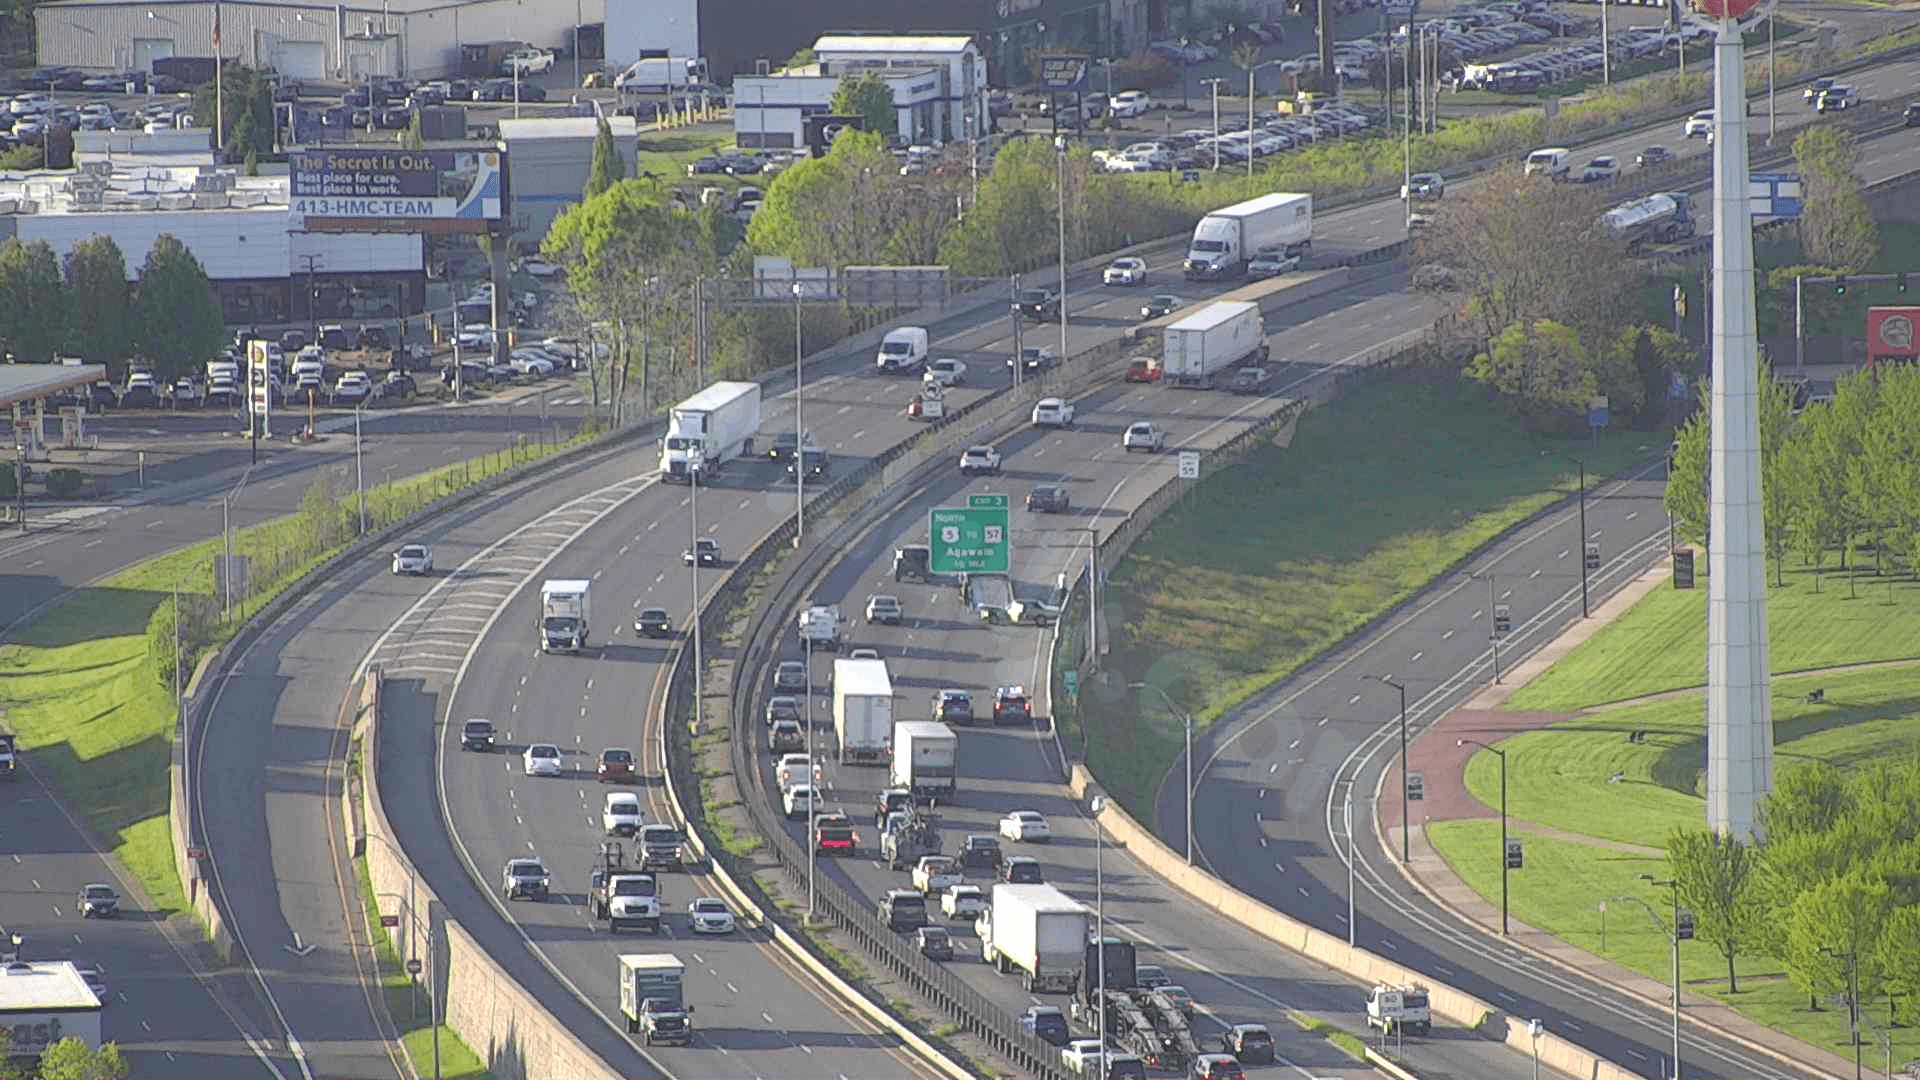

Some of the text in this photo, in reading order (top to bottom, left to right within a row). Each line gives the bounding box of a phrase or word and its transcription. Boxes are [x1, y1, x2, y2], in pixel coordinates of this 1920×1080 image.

[295, 155, 434, 170] The Secret Is Out.
[296, 172, 400, 185] Best place for care.
[296, 184, 400, 196] Best place to work.
[295, 200, 433, 215] 413-HMC-TEAM
[995, 496, 1002, 506] 3
[986, 529, 1000, 540] 57
